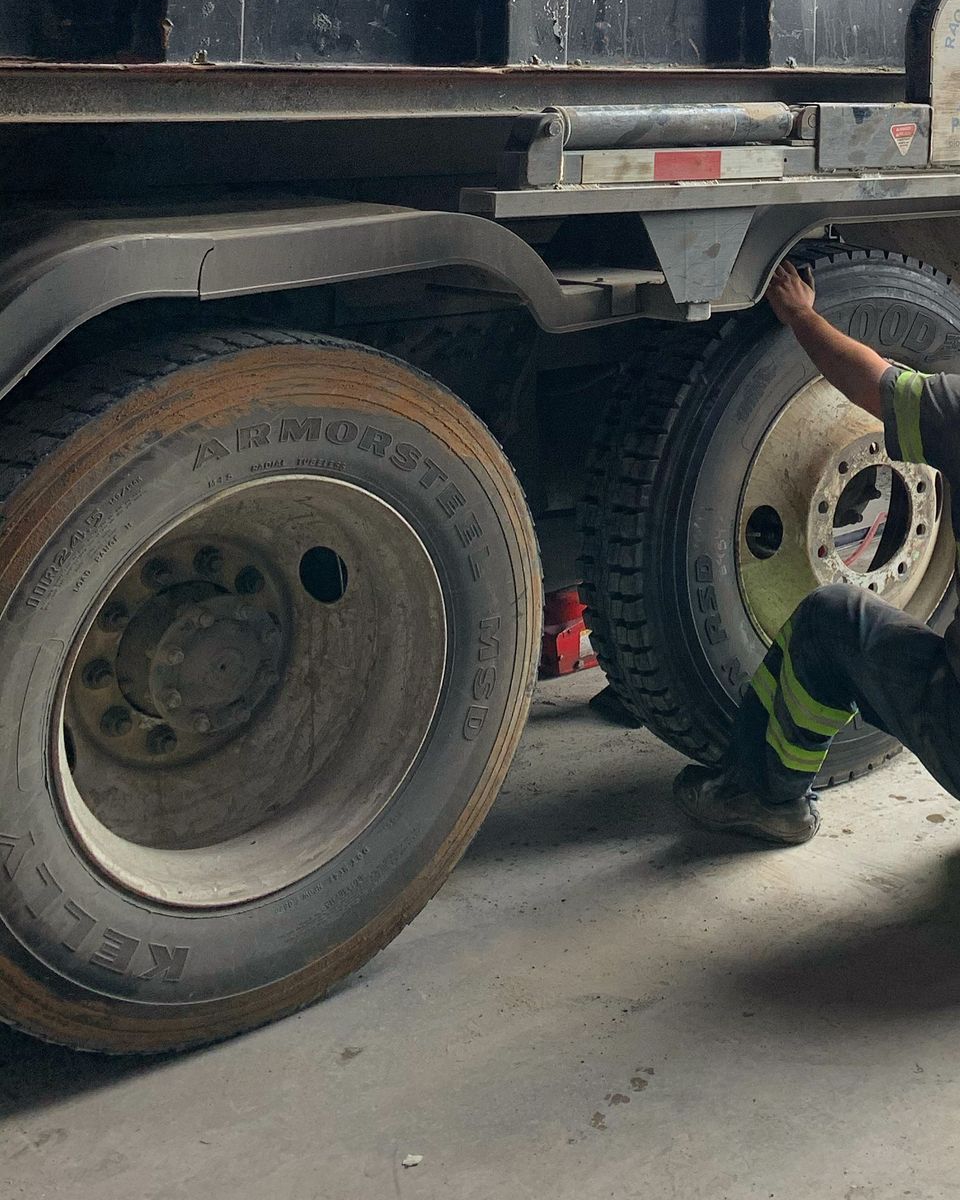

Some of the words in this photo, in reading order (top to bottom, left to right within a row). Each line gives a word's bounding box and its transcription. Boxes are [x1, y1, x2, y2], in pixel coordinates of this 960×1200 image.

[192, 415, 495, 584] ARMORSTEEL
[462, 615, 502, 744] MSD
[0, 830, 191, 982] KELLY
